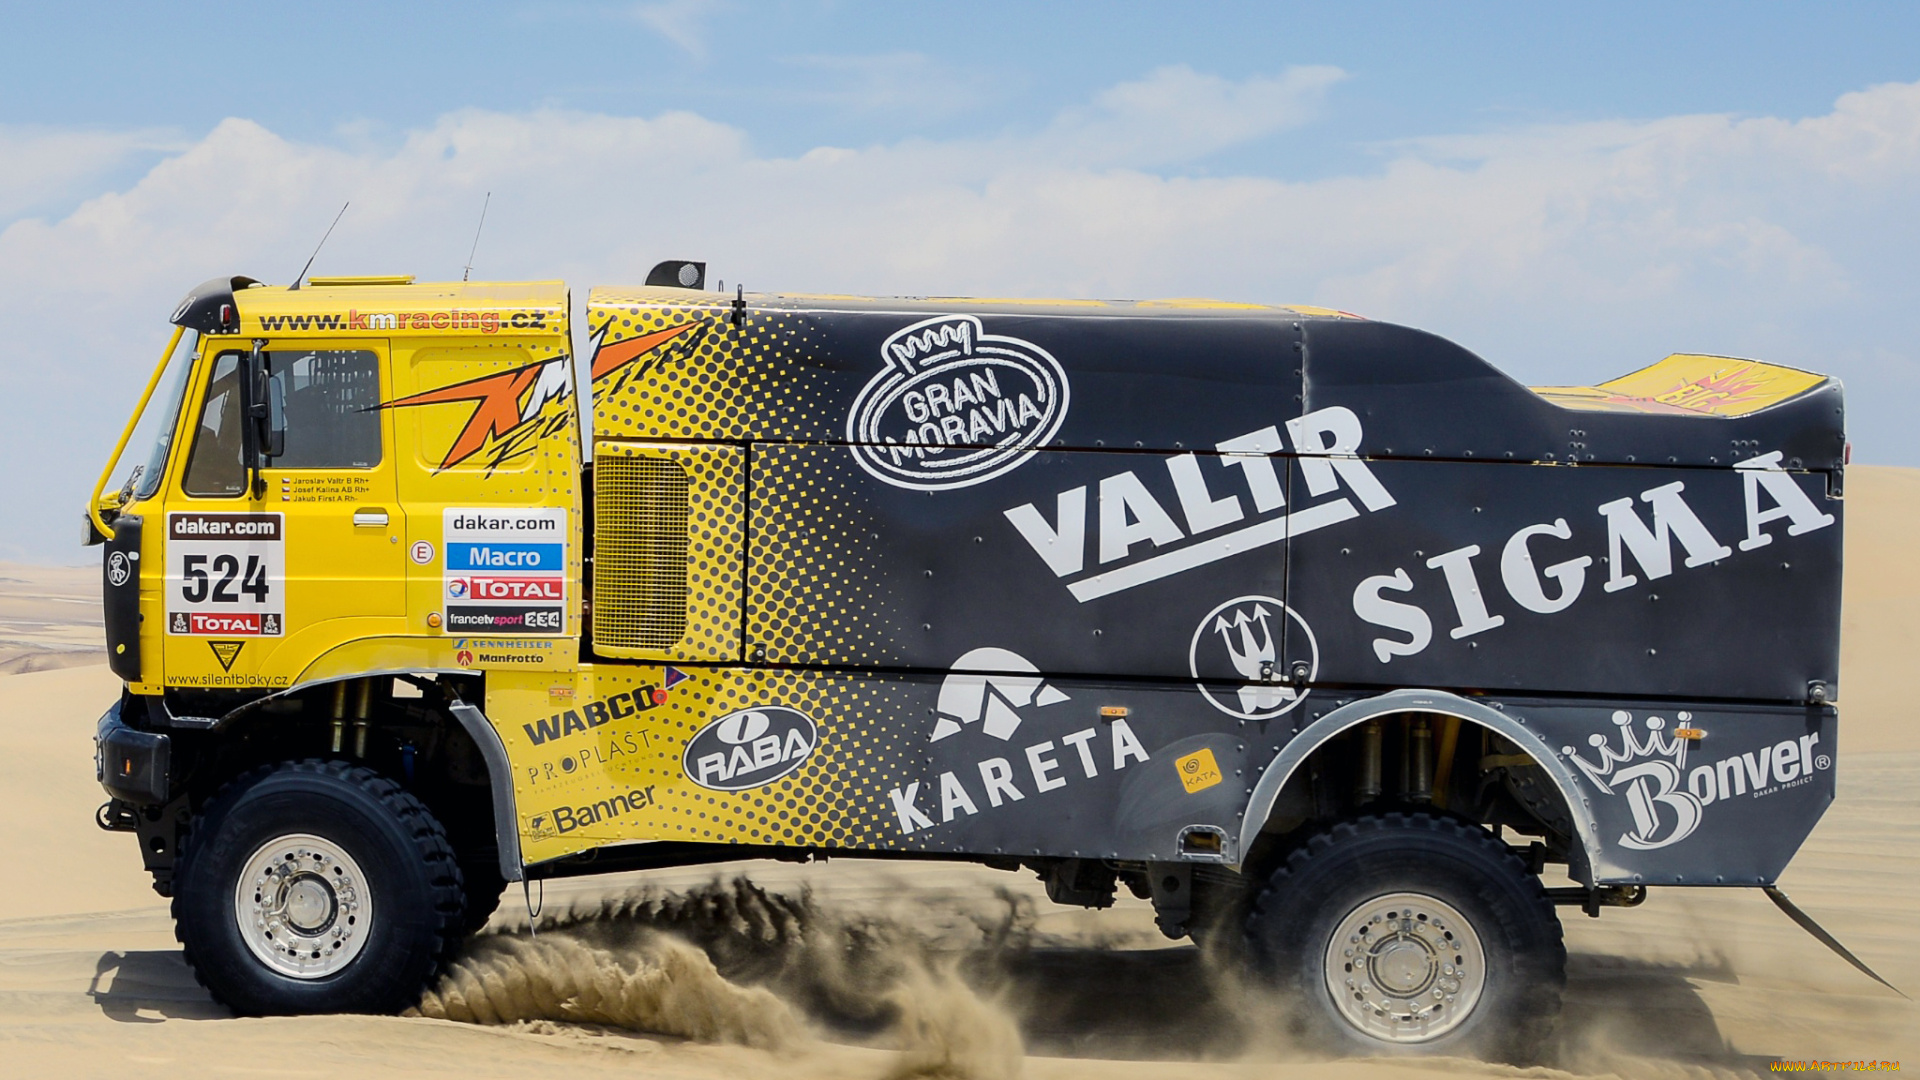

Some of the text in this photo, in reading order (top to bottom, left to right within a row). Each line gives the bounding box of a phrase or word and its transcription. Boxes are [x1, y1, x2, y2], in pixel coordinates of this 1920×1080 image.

[259, 308, 546, 334] www.kmracing.cz
[903, 367, 1001, 423] GRAN
[885, 393, 1043, 466] MORAVIA
[1003, 406, 1397, 577] VALTR
[175, 517, 275, 535] dakar.com
[453, 515, 555, 530] dakar.com
[417, 546, 427, 559] E
[469, 547, 541, 566] Macro
[1353, 450, 1835, 663] SIGMA
[182, 554, 269, 603] 524
[473, 579, 560, 597] TOTAL
[193, 615, 258, 631] TOTAL
[472, 640, 552, 649] SENNHEISER
[479, 653, 543, 663] Manfrotto
[168, 673, 288, 686] www.silentbloky.cz
[522, 684, 660, 746] WABCO
[528, 729, 650, 785] PROPLAST
[698, 728, 810, 786] RABA
[890, 718, 1150, 835] KARETA
[1185, 771, 1217, 787] KATA
[1753, 776, 1813, 799] DAKAR PROJECT
[552, 784, 656, 834] Banner
